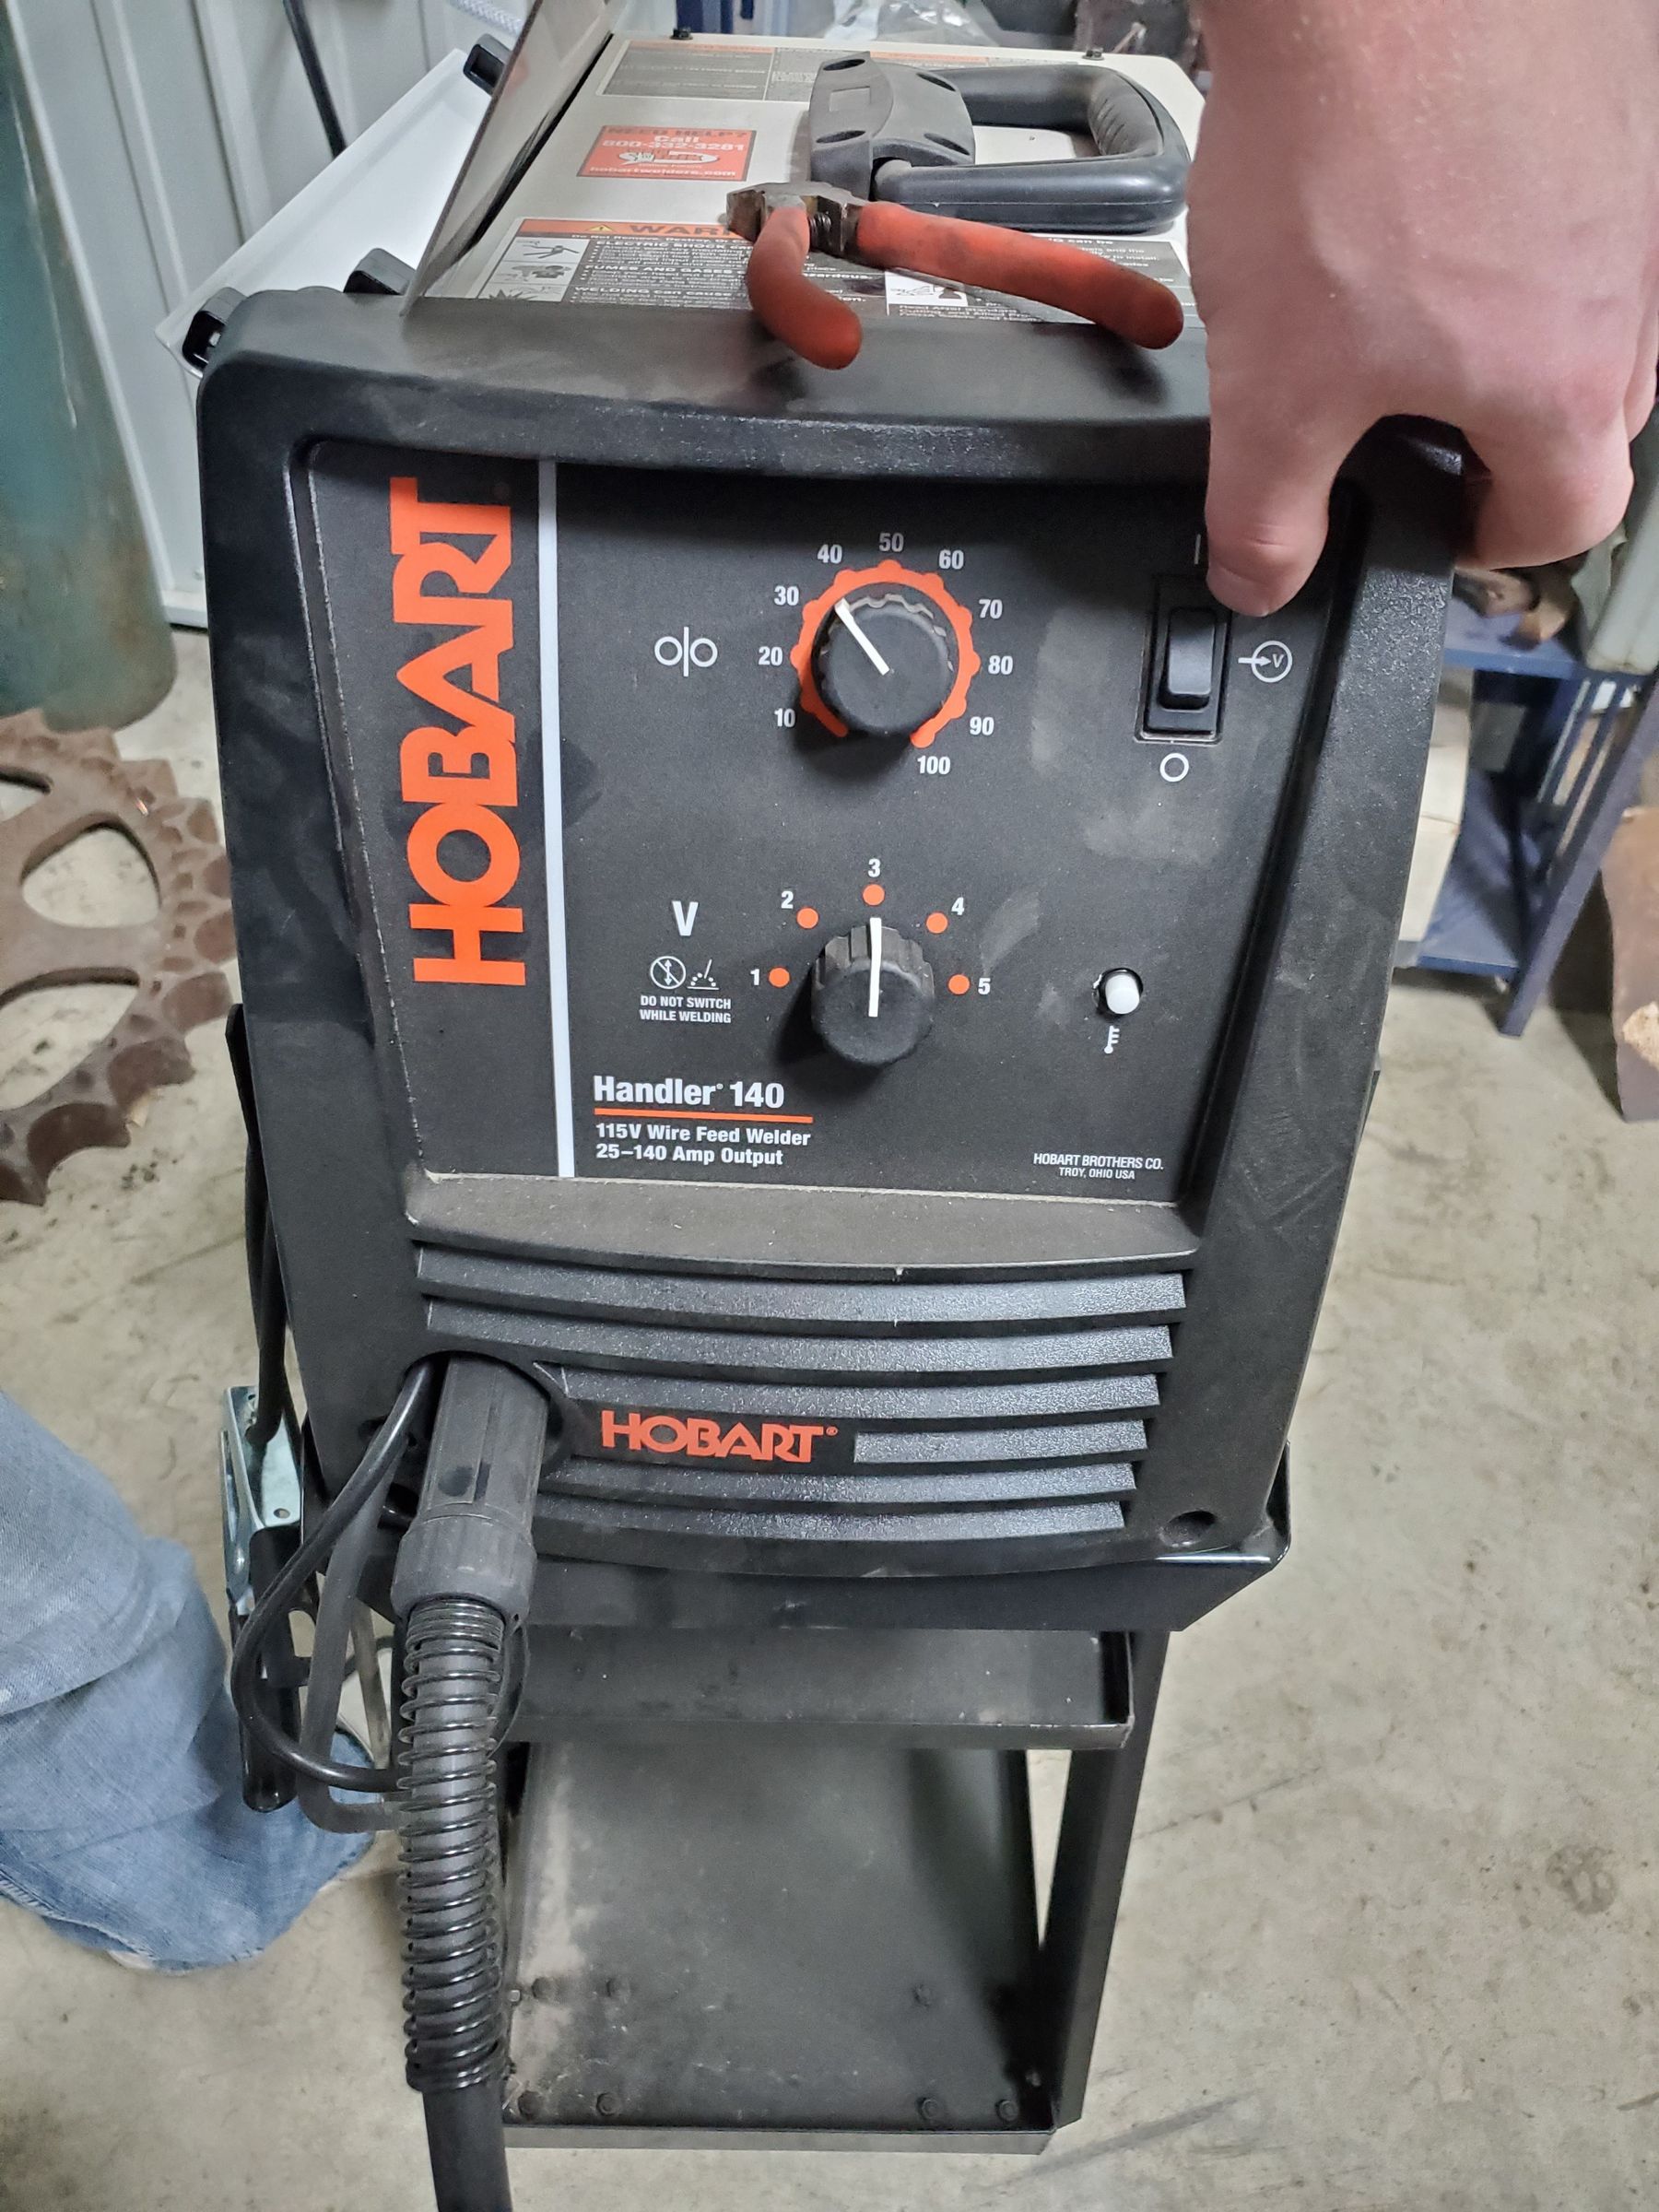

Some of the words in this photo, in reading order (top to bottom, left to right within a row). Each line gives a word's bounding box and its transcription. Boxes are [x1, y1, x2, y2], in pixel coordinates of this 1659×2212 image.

[878, 533, 904, 552] 50
[818, 545, 842, 564] 40
[938, 549, 964, 570] 60
[774, 585, 799, 606] 30
[978, 599, 1003, 618] 70
[758, 646, 783, 665] 20
[988, 655, 1013, 675] 80
[774, 708, 795, 728] 10
[970, 716, 994, 735] 90
[390, 477, 526, 986] HOBART
[917, 756, 951, 775] 100
[867, 858, 881, 877] 3
[781, 890, 794, 909] 2
[951, 897, 965, 916] 4
[672, 900, 699, 936] V
[750, 969, 760, 986] 1
[978, 977, 991, 995] 5
[640, 994, 656, 1006] DO
[660, 995, 684, 1008] NOT
[687, 997, 732, 1009] SWITCH
[640, 1009, 677, 1021] WHILE
[679, 1010, 732, 1023] WELDING
[730, 1081, 784, 1108] 140
[596, 1123, 641, 1140] 115V
[647, 1124, 690, 1142] Wire
[696, 1126, 740, 1143] Feed
[747, 1127, 811, 1146] Welder
[673, 1147, 714, 1165] Amp
[721, 1147, 783, 1168] Output
[1033, 1153, 1081, 1166] HOBART
[1082, 1155, 1143, 1169] BROTHERS
[1145, 1158, 1165, 1171] CO.
[1059, 1167, 1087, 1179] TROY,
[1088, 1168, 1112, 1179] OHIO
[1115, 1169, 1135, 1180] USA
[601, 1409, 824, 1464] HOBART
